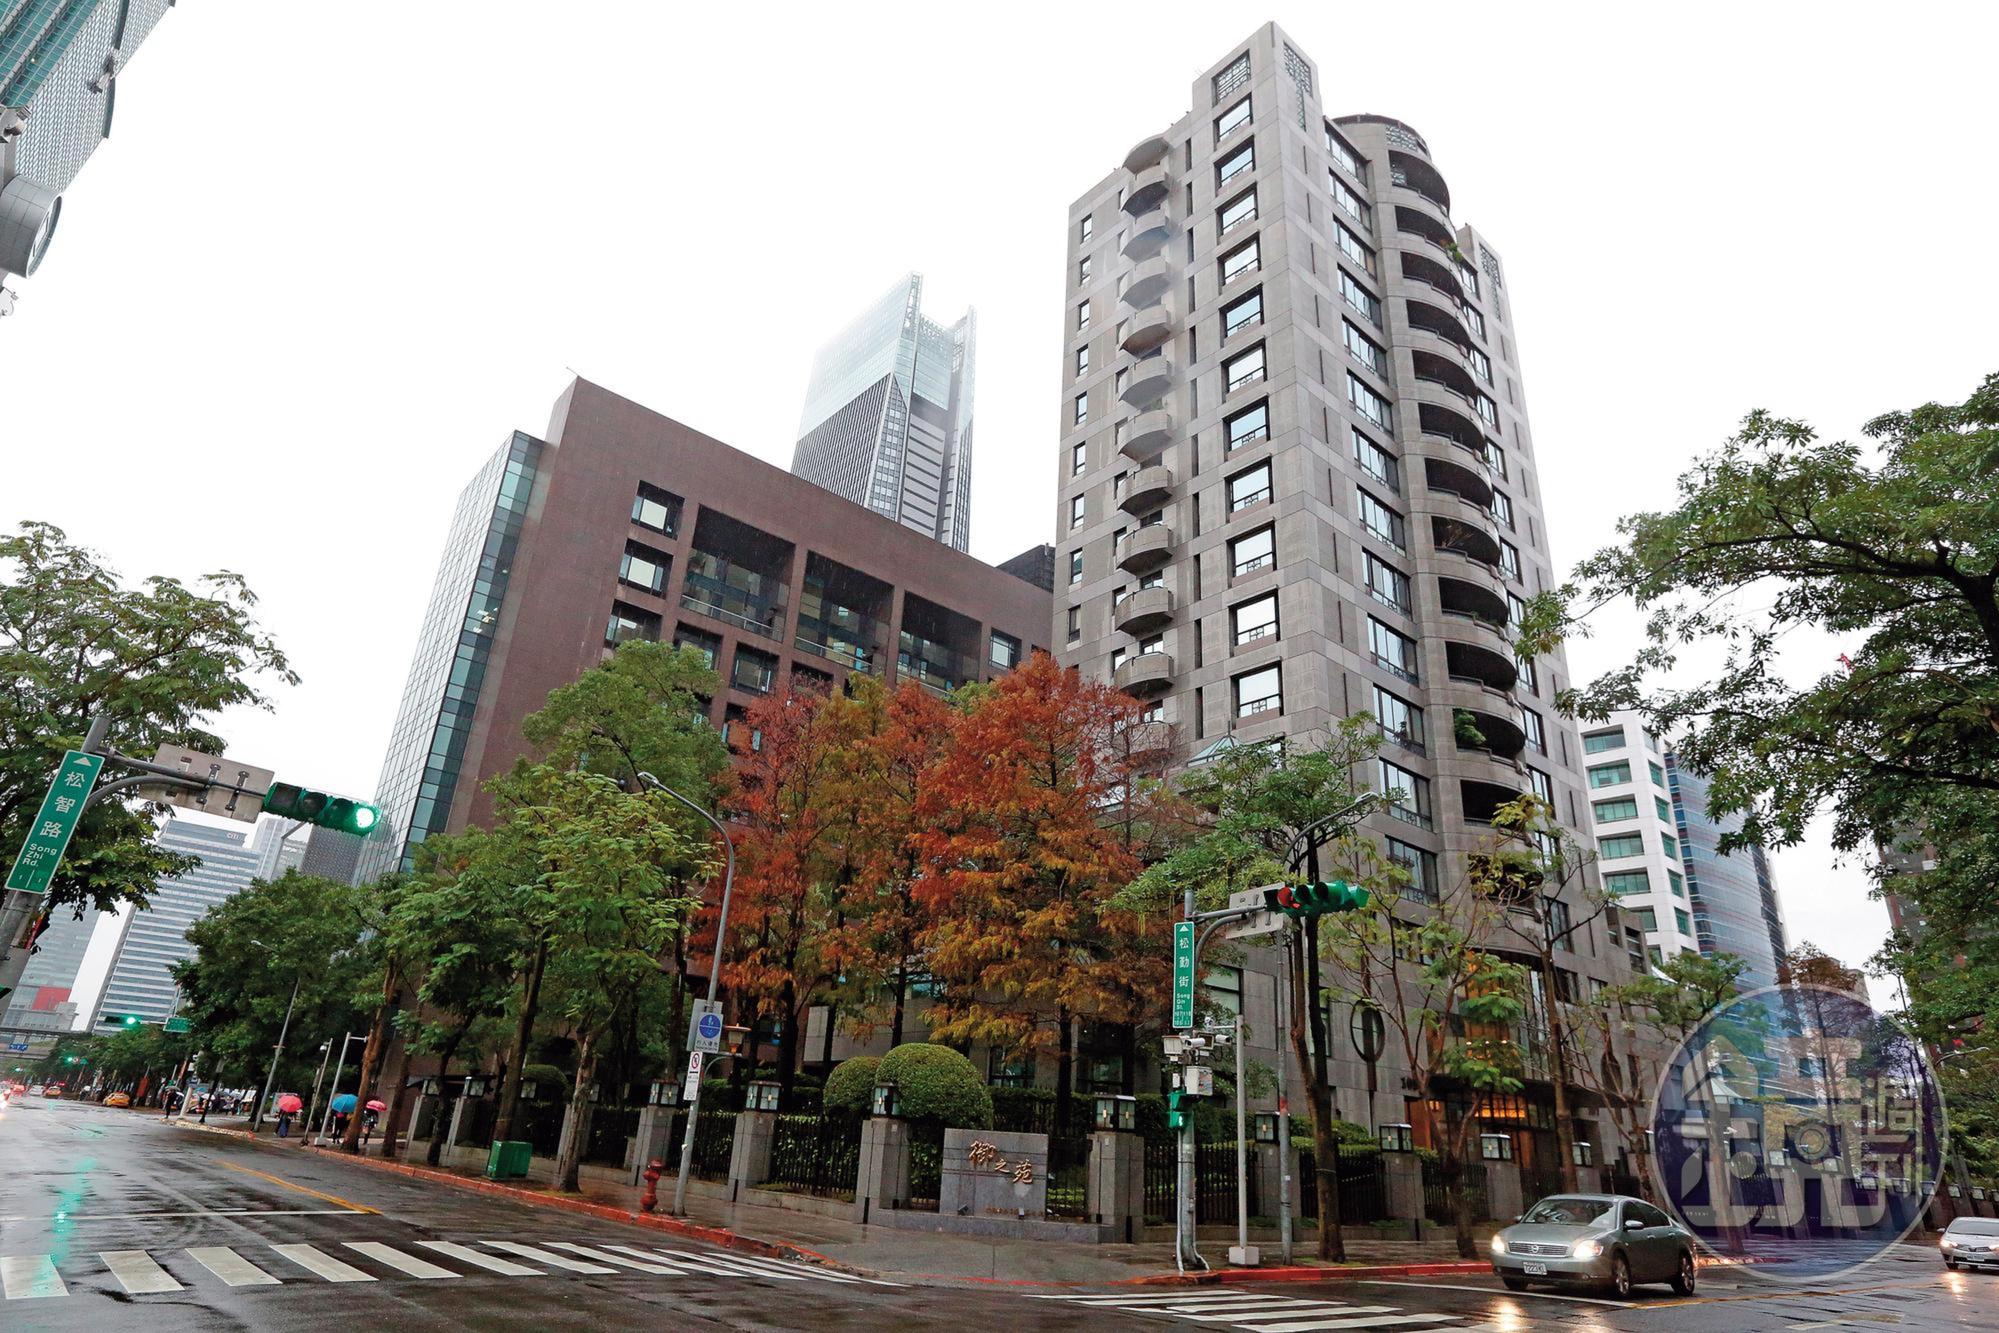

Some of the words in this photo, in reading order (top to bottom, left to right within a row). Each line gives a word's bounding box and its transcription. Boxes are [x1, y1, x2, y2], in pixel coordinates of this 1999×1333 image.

[40, 771, 85, 838] 松智路
[25, 851, 44, 860] Zhi
[29, 843, 57, 856] Song
[22, 858, 39, 867] Rd.
[1179, 937, 1190, 988] 松勤街
